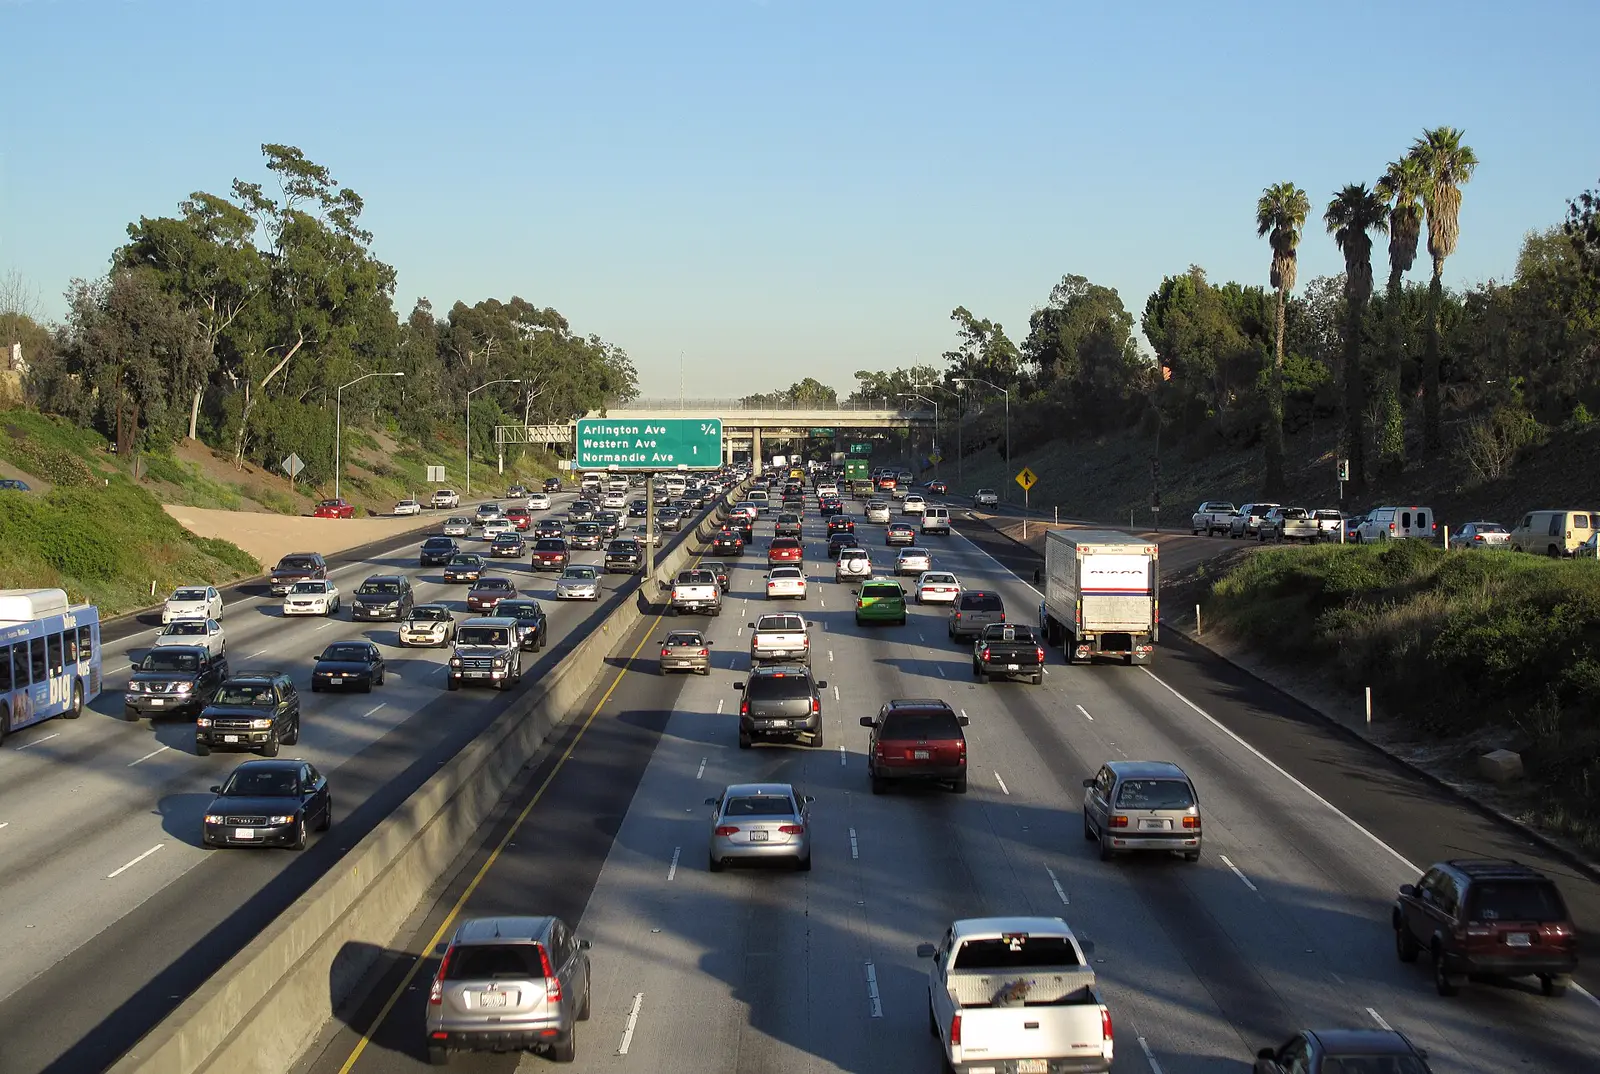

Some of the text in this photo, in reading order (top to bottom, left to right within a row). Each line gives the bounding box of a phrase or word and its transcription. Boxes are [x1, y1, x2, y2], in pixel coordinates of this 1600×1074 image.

[583, 425, 639, 437] Arlington
[644, 424, 666, 435] Ave
[583, 438, 657, 449] Western Ave
[692, 445, 698, 455] 1
[583, 452, 674, 463] Normandie Ave
[77, 656, 91, 677] bus
[49, 665, 71, 710] big
